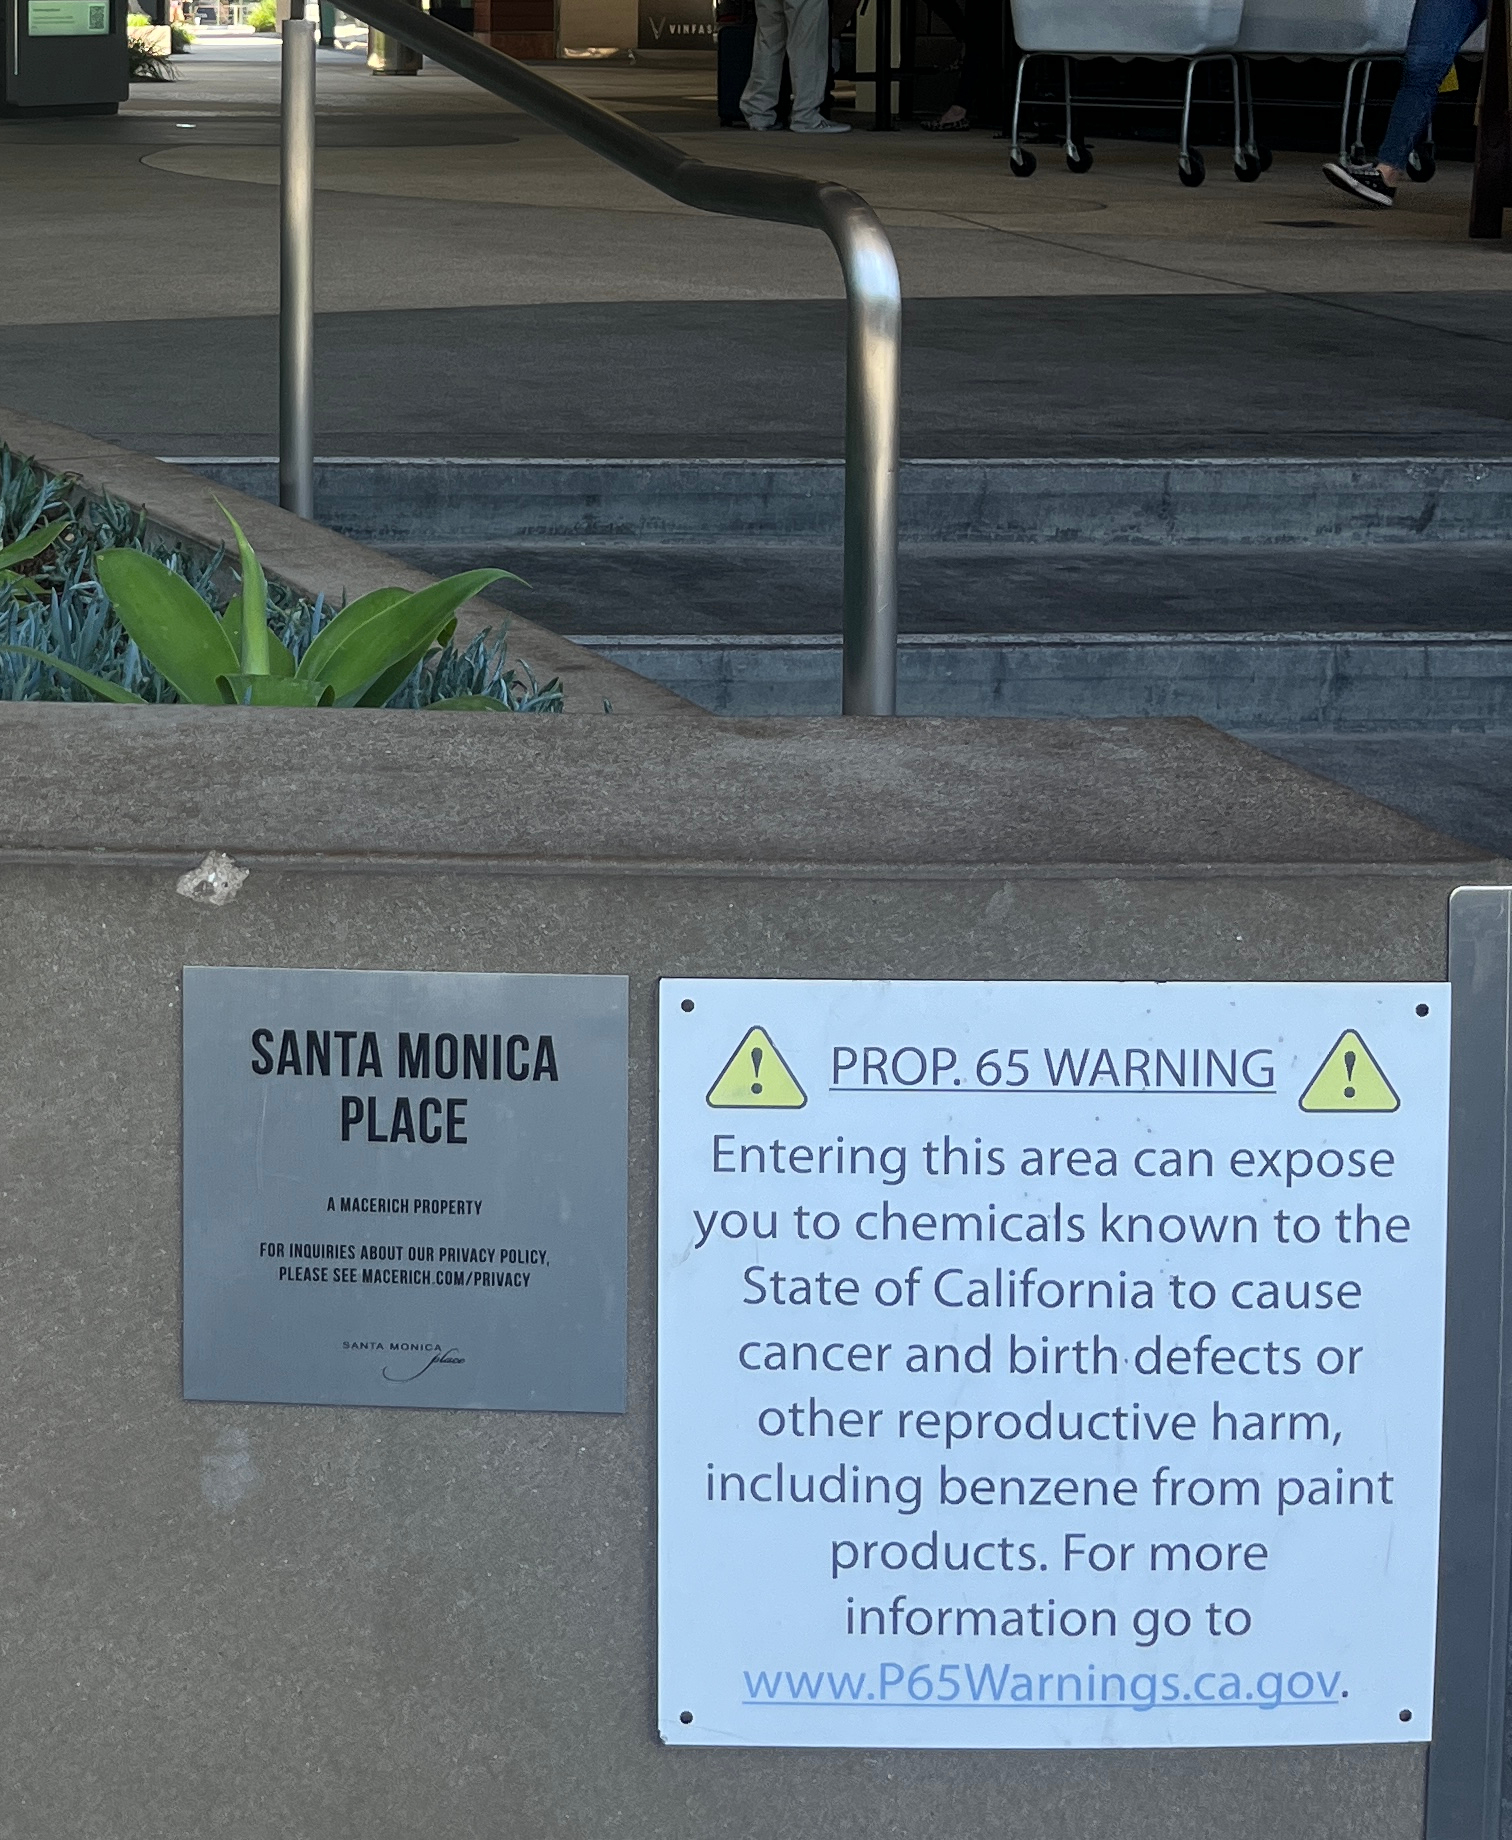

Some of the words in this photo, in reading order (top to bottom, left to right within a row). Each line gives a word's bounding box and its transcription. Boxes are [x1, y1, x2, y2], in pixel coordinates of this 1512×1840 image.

[669, 24, 716, 35] VINFAS
[252, 1029, 383, 1077] SANTA
[399, 1032, 558, 1081] MONICA
[833, 1047, 960, 1087] PROP.
[977, 1049, 1029, 1087] 65
[1044, 1048, 1276, 1088] WARNING
[341, 1096, 468, 1144] PLACE
[713, 1135, 906, 1185] Entering
[923, 1135, 1004, 1176] this
[1021, 1148, 1118, 1177] area
[1134, 1149, 1212, 1178] can
[1231, 1149, 1395, 1185] expose
[327, 1197, 335, 1212] A
[341, 1197, 408, 1214] MACERICH
[414, 1199, 482, 1216] PROPERTY
[693, 1211, 776, 1250] you
[794, 1206, 839, 1240] to
[856, 1201, 1084, 1243] chemicals
[1102, 1202, 1256, 1244] known
[1274, 1204, 1320, 1244] to
[1336, 1204, 1410, 1243] the
[260, 1242, 284, 1258] FOR
[290, 1243, 355, 1260] INQUIRIES
[361, 1245, 403, 1261] ABOUT
[408, 1247, 434, 1262] OUR
[439, 1248, 495, 1264] PRIVACY
[500, 1249, 550, 1267] POLICY,
[279, 1267, 329, 1283] PLEASE
[333, 1269, 357, 1284] SEE
[362, 1269, 530, 1288] MACERICH.COM/PRIVACY
[743, 1266, 859, 1306] State
[875, 1266, 922, 1307] of
[935, 1268, 1152, 1309] California
[1172, 1275, 1215, 1310] to
[1232, 1281, 1361, 1310] cause
[342, 1341, 385, 1351] SANTA
[390, 1342, 442, 1352] MONICA
[739, 1342, 891, 1372] cancer
[906, 1334, 990, 1374] and
[1010, 1334, 1118, 1375] birth
[1135, 1335, 1300, 1376] defects
[1317, 1347, 1364, 1375] or
[758, 1397, 884, 1438] other
[899, 1400, 1195, 1448] reproductive
[1213, 1401, 1341, 1447] harm,
[708, 1462, 922, 1515] including
[941, 1465, 1137, 1507] benzene
[1153, 1466, 1259, 1507] from
[1278, 1468, 1394, 1515] paint
[831, 1530, 1047, 1579] products.
[1065, 1534, 1134, 1572] For
[1151, 1543, 1268, 1572] more
[847, 1596, 1116, 1637] information
[1134, 1609, 1190, 1647] go
[1206, 1603, 1251, 1637] to
[742, 1663, 1349, 1712] www.P65Warnings.ca.gov.
